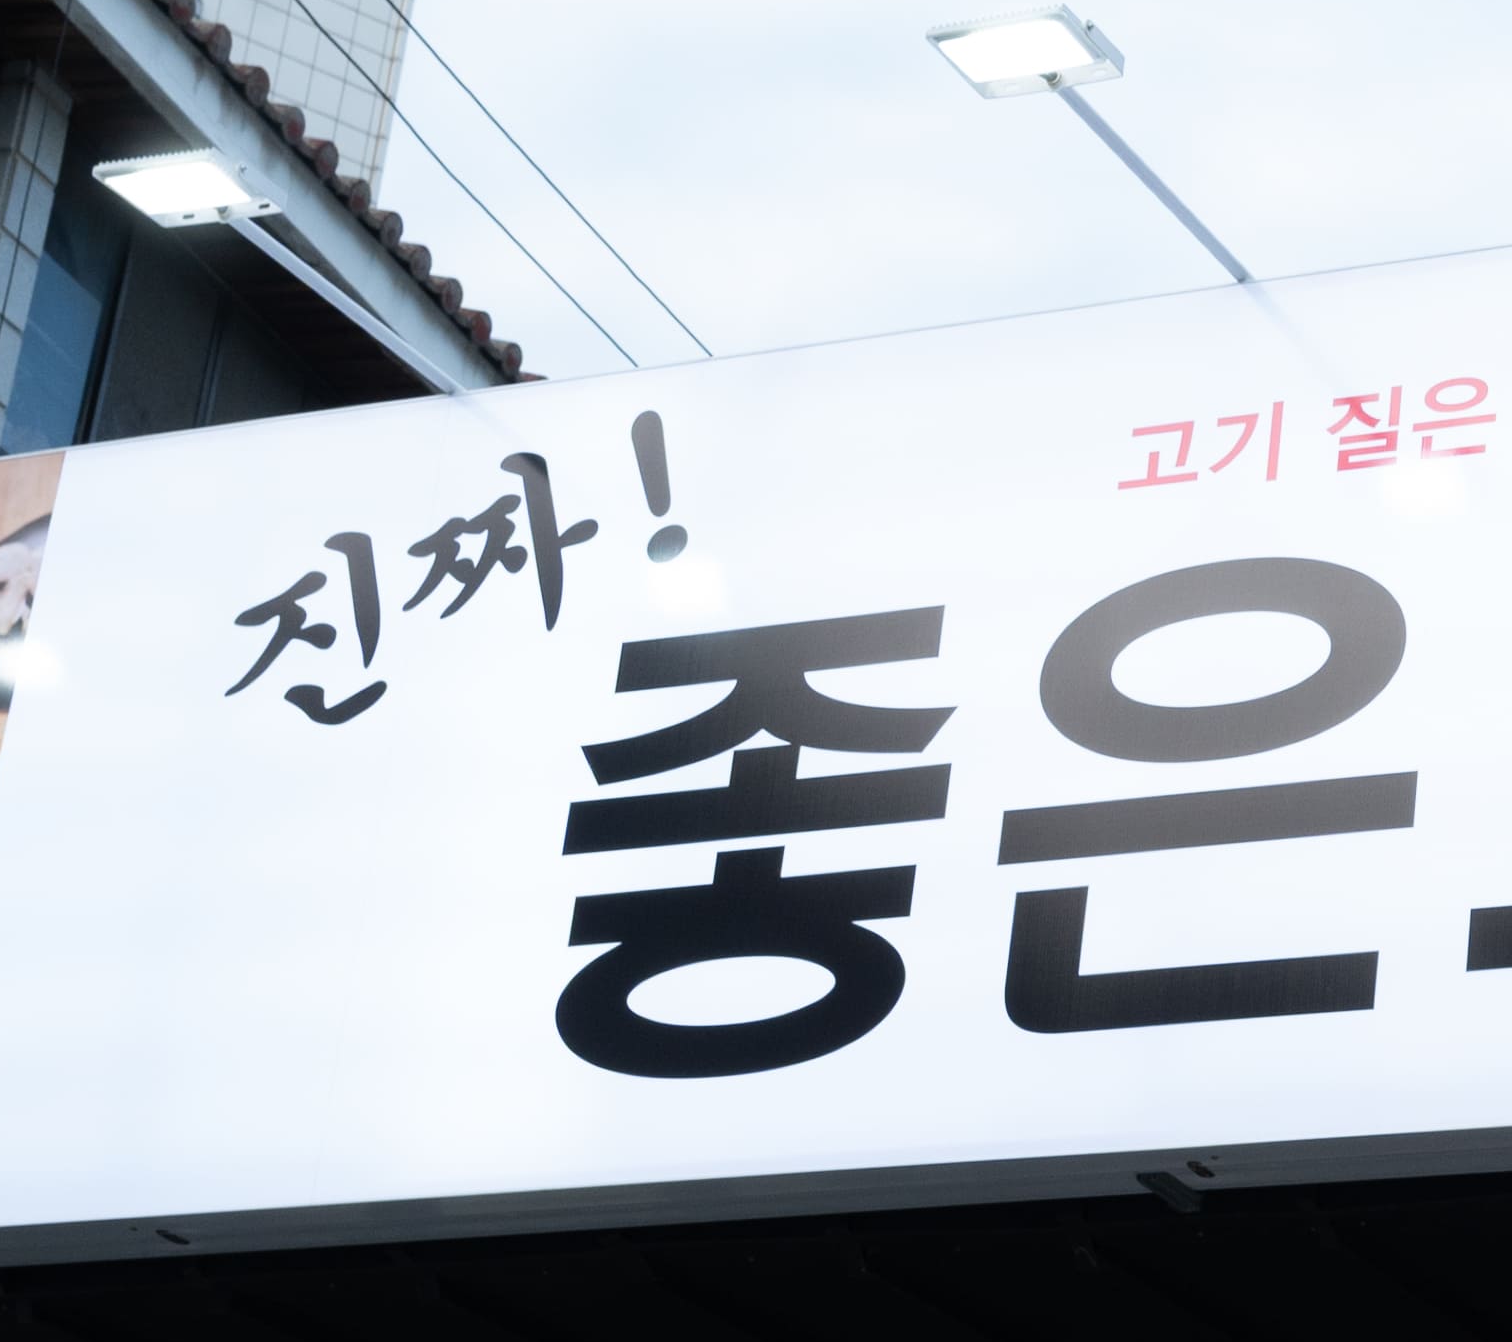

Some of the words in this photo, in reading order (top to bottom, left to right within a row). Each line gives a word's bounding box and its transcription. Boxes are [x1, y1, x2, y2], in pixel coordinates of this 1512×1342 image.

[1117, 400, 1285, 491] 고기
[1325, 374, 1498, 474] 질은
[225, 410, 688, 725] 진짜!
